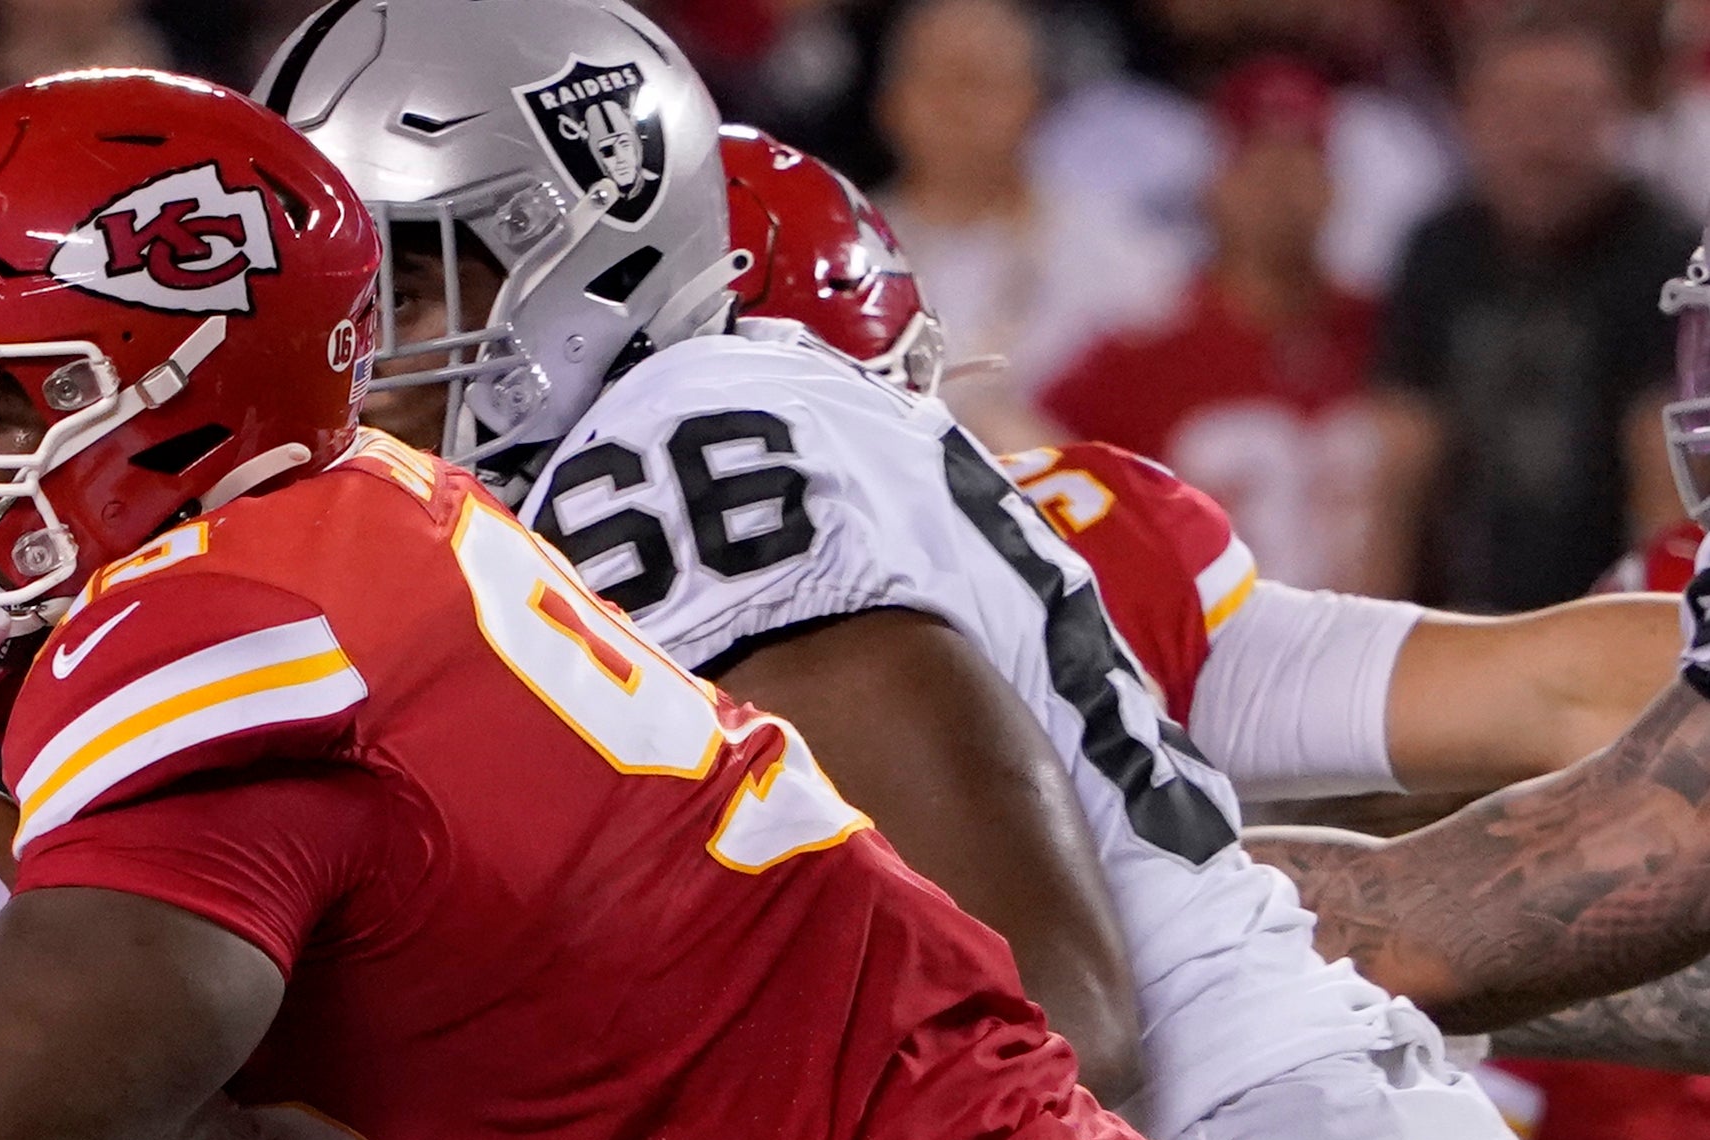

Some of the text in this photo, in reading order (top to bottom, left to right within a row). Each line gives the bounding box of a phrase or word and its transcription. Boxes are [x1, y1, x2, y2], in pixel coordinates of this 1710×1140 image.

[538, 67, 637, 110] RAIDERS
[97, 196, 251, 291] KC
[332, 326, 353, 366] 16
[530, 408, 818, 614] 66
